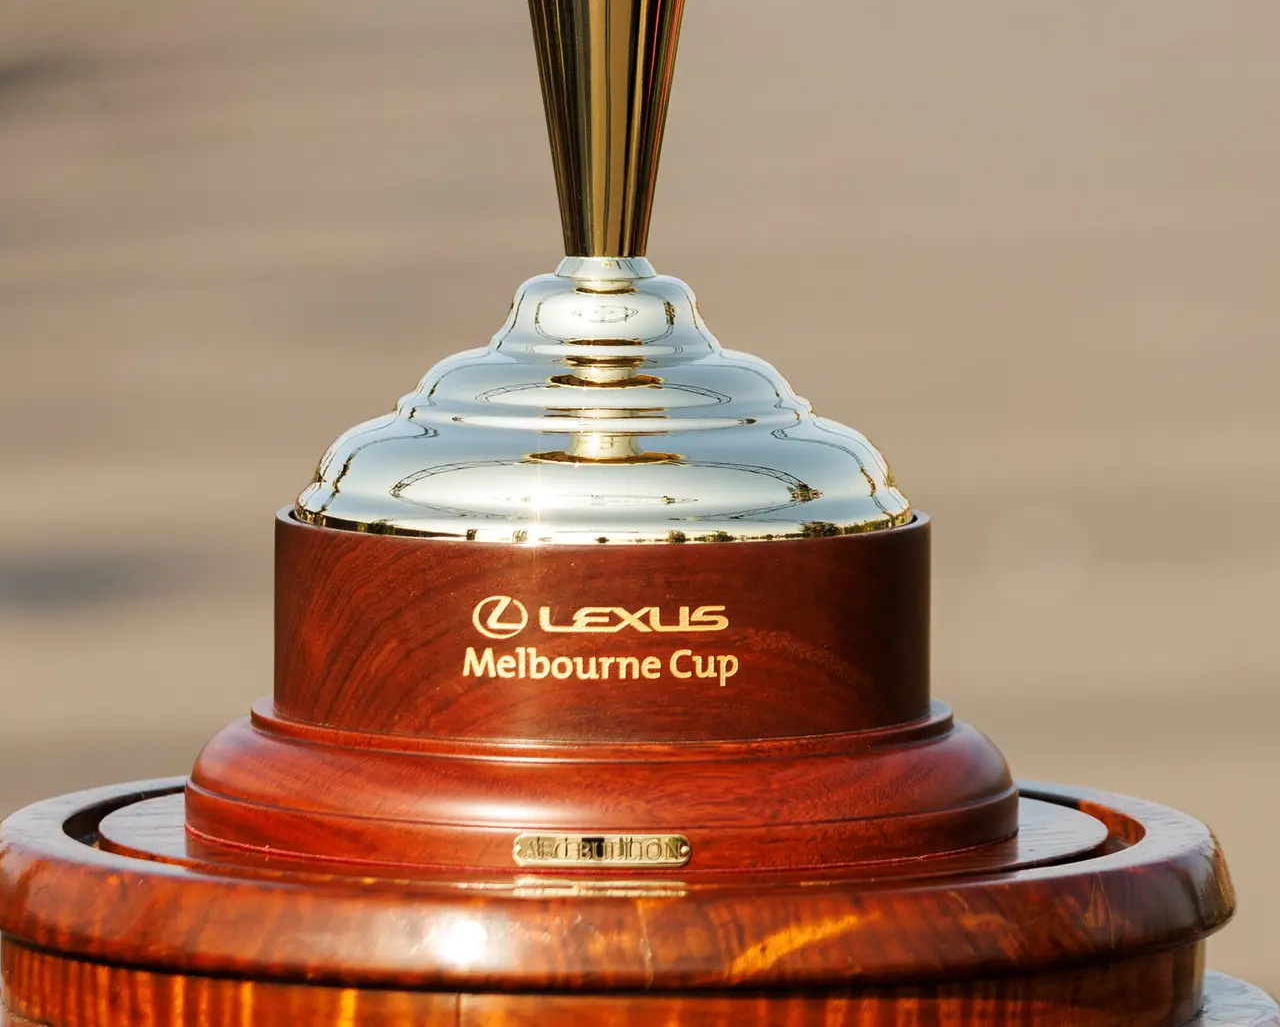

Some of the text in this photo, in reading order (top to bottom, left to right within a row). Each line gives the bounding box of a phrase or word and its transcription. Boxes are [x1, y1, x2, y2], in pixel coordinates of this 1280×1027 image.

[539, 605, 729, 632] LEXUS
[462, 646, 739, 686] Melbourne Cup
